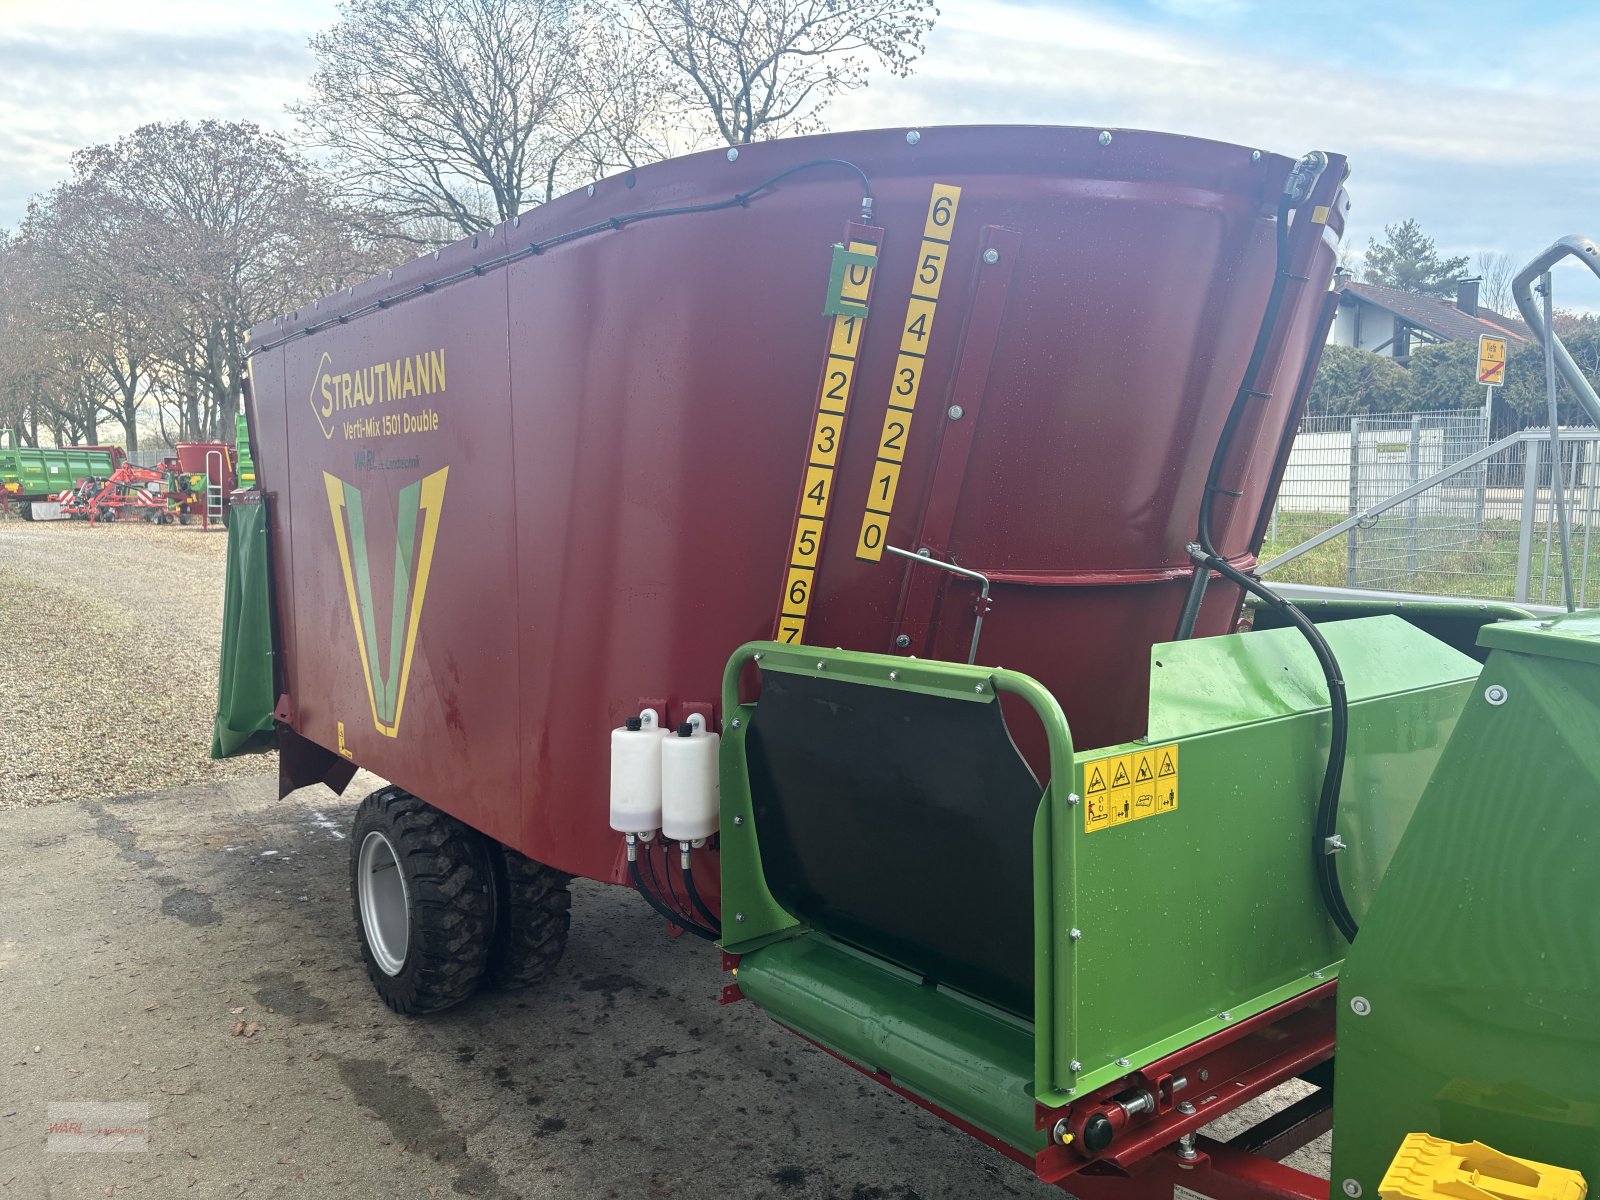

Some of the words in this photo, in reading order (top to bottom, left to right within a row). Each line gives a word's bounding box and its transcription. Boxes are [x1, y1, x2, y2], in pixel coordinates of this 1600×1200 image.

[932, 197, 952, 226] 6
[850, 264, 868, 286] 0
[919, 255, 940, 284] 5
[844, 316, 856, 344] 1
[907, 313, 927, 342] 4
[321, 348, 446, 417] STRAUTMANN
[826, 371, 847, 400] 2
[896, 368, 915, 395] 3
[343, 416, 381, 440] Verti-Mix
[382, 414, 401, 436] 1501
[403, 408, 439, 433] Double
[883, 422, 905, 450] 2
[817, 426, 836, 453] 3
[807, 479, 825, 505] 4
[879, 475, 891, 500] 1
[798, 530, 817, 555] 5
[863, 524, 881, 549] 0
[789, 580, 807, 604] 6
